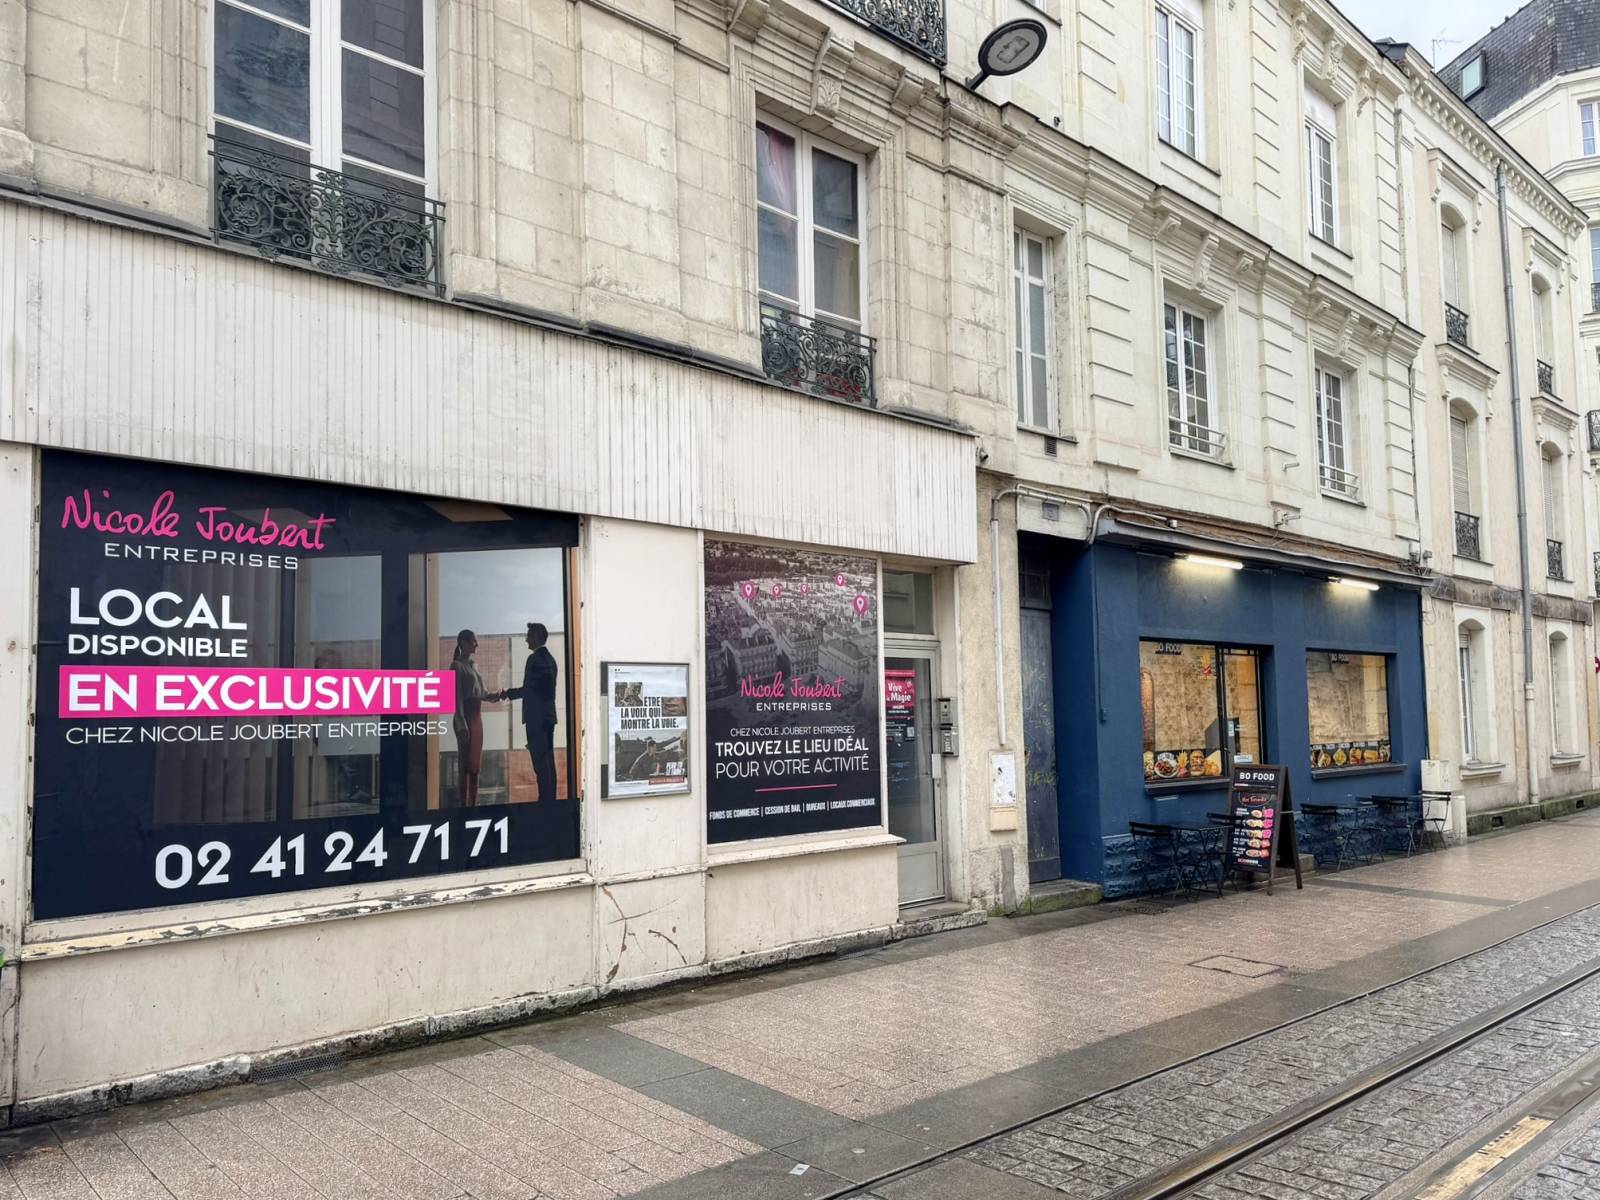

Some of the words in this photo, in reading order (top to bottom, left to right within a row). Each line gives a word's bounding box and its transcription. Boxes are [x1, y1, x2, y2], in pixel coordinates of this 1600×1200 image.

[61, 488, 179, 537] Nicole
[195, 507, 336, 550] Joubert
[104, 542, 299, 570] ENTREPRISES
[70, 587, 248, 630] LOCAL
[68, 633, 248, 658] DISPONIBLE
[69, 673, 138, 712] EN
[155, 671, 441, 711] EXCLUSIVITÉ
[741, 671, 785, 698] Nicole
[790, 675, 847, 700] Joubert
[888, 682, 902, 692] Vive
[756, 702, 832, 712] ENTREPRISES
[891, 691, 912, 704] Magie
[620, 707, 629, 718] LA
[630, 707, 647, 718] VOIX
[648, 707, 661, 719] QUI
[620, 718, 650, 730] MONTRE
[651, 718, 660, 729] LA
[65, 726, 134, 744] CHEZ
[140, 725, 224, 743] NICOLE
[230, 723, 324, 741] JOUBERT
[328, 720, 448, 738] ENTREPRISES
[730, 727, 751, 738] CHEZ
[751, 726, 779, 737] NICOLE
[780, 725, 811, 736] JOUBERT
[813, 725, 856, 735] ENTREPRISES
[715, 740, 783, 757] TROUVEZ
[785, 739, 801, 754] LE
[804, 738, 831, 753] LIEU
[834, 735, 869, 751] IDÉAL
[715, 760, 760, 780] POUR
[763, 758, 810, 776] VOTRE
[813, 753, 870, 773] ACTIVITÉ
[1239, 771, 1251, 780] BO
[1252, 772, 1275, 781] FOOD
[709, 810, 726, 820] FONDS
[726, 809, 733, 818] DE
[733, 807, 760, 818] COMMERCE
[764, 805, 784, 815] CESSION
[784, 804, 791, 814] DE
[155, 840, 232, 889] 02
[249, 833, 305, 878] 41
[323, 827, 388, 873] 24
[402, 820, 450, 864] 71
[464, 816, 509, 857] 71
